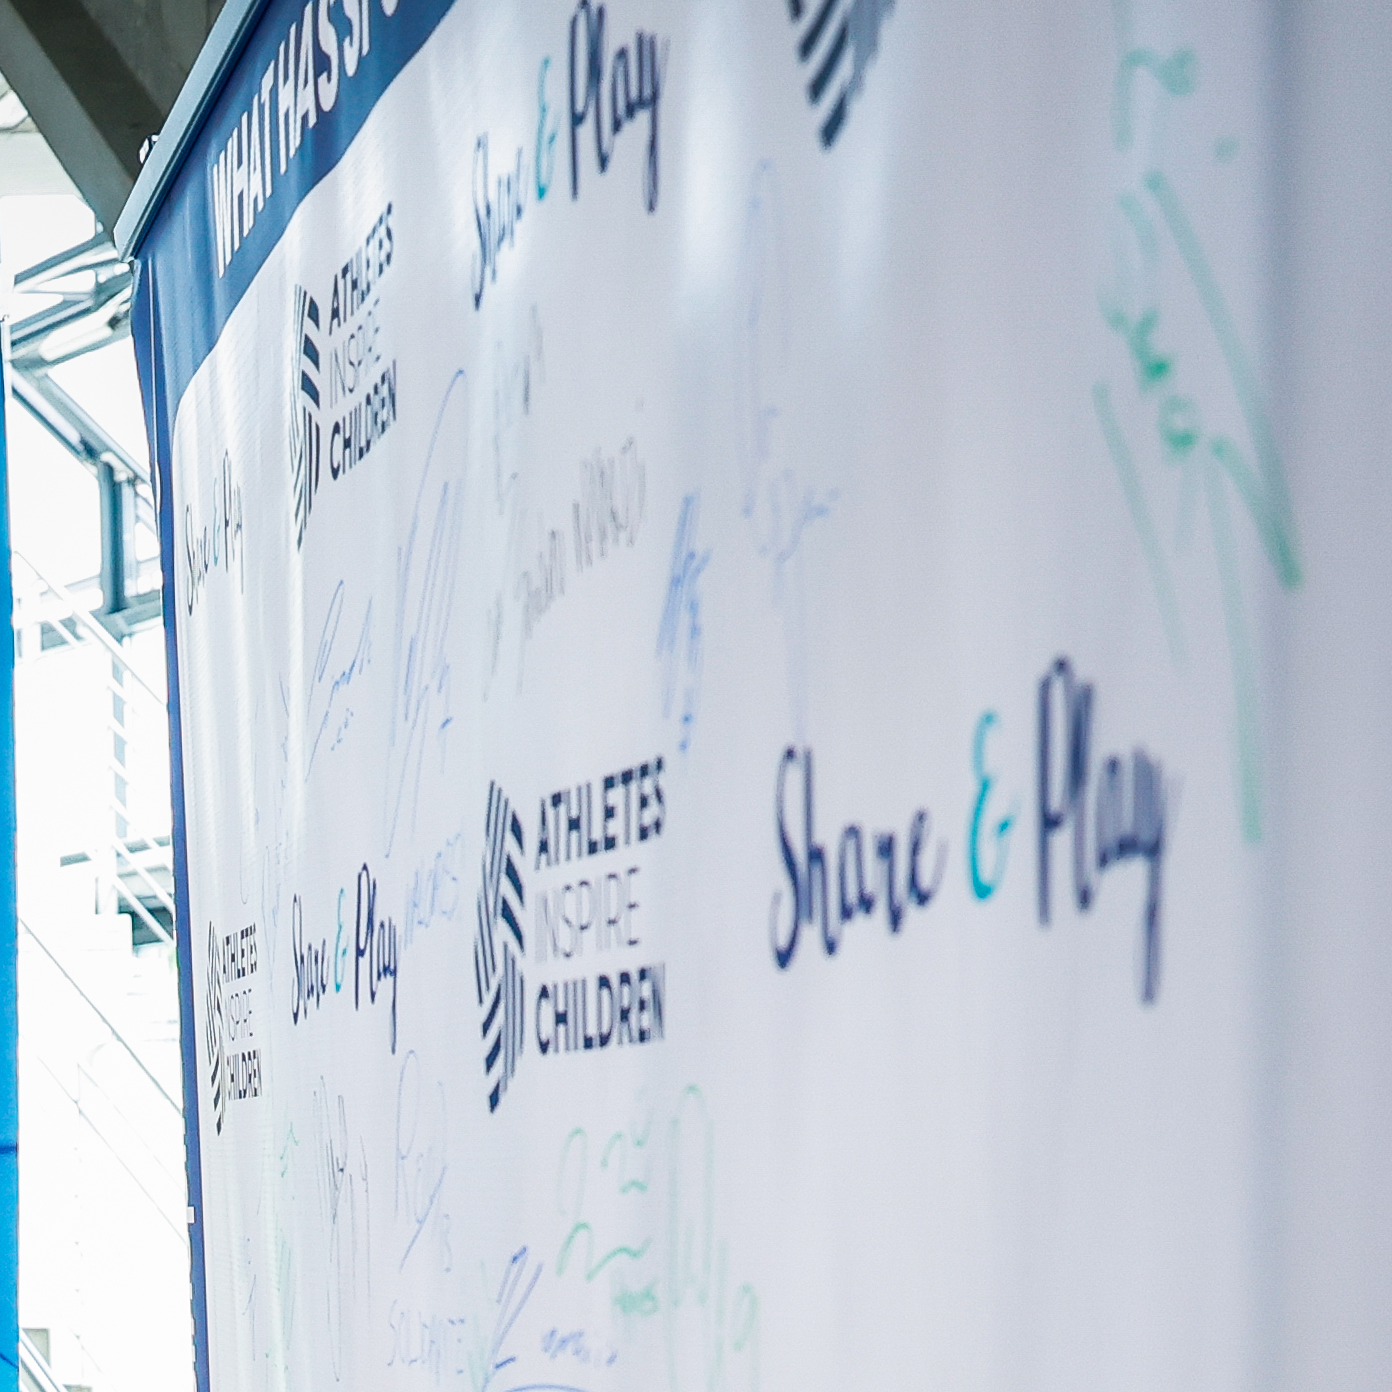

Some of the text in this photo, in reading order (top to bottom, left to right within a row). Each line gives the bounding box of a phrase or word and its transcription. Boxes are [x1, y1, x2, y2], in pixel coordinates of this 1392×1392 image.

[212, 0, 339, 279] WHAT HAS
[567, 0, 668, 214] Play
[328, 202, 395, 335] ATHLETES
[329, 359, 397, 482] CHILDREN
[534, 755, 666, 870] ATHLETES
[770, 655, 1185, 1005] Share & Play
[222, 922, 259, 985] ATHLETES
[291, 894, 329, 1026] Share
[355, 862, 400, 1055] Play
[536, 866, 641, 963] INSPIRE
[535, 963, 666, 1055] CHILDREN
[226, 1048, 262, 1101] CHILDREN
